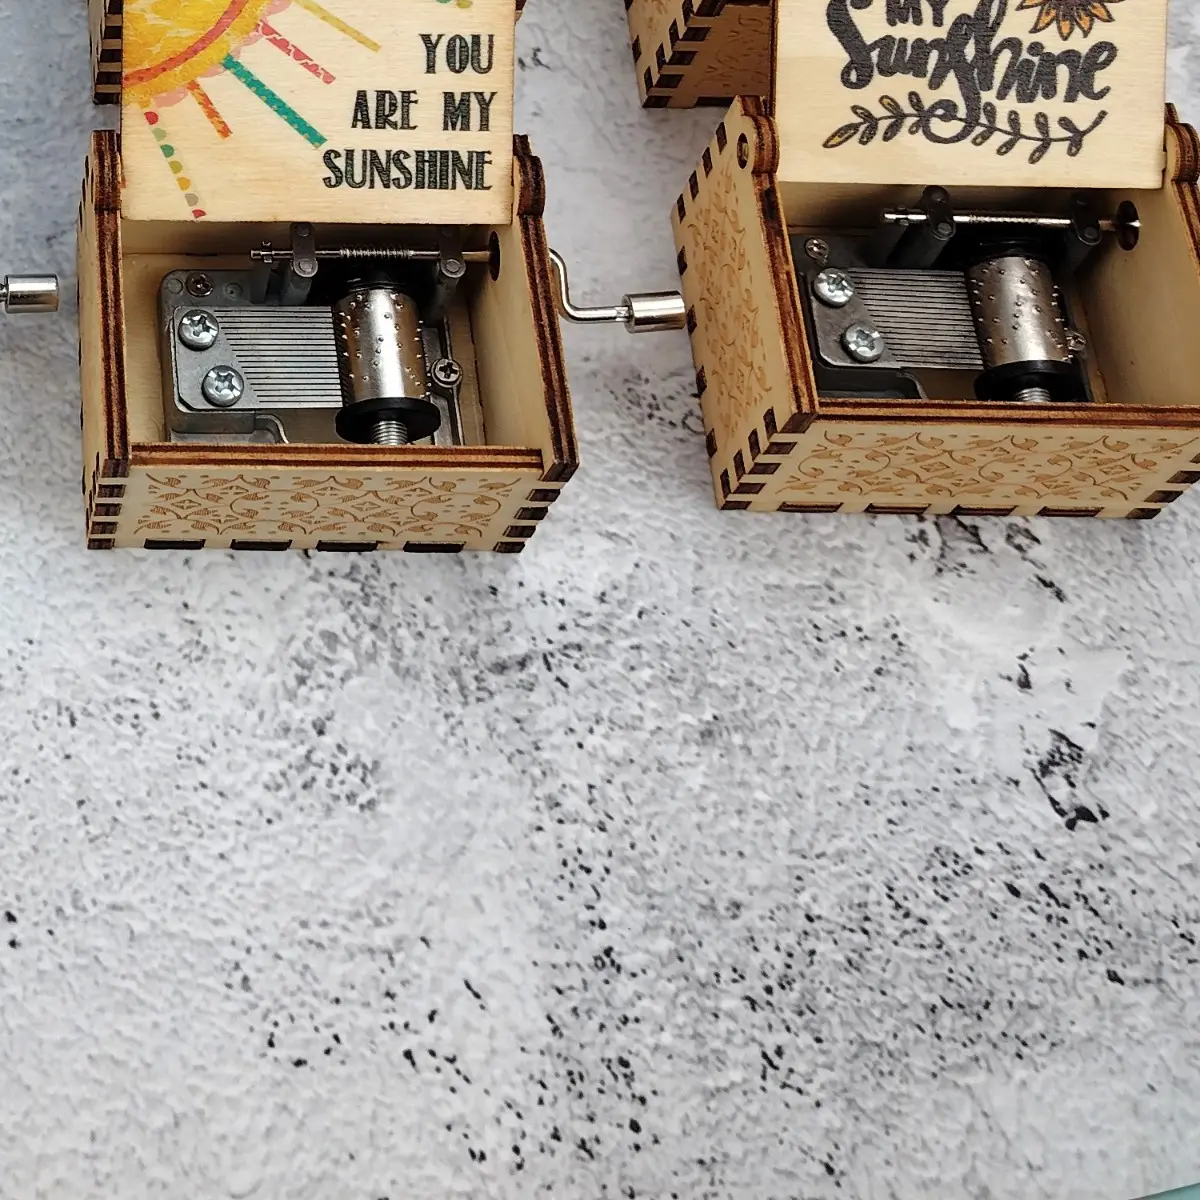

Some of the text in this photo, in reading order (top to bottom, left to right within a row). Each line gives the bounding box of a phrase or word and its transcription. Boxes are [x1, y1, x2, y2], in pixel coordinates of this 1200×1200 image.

[418, 33, 495, 74] YOU
[351, 90, 498, 131] ARE MY
[322, 149, 493, 190] SUNSHINE
